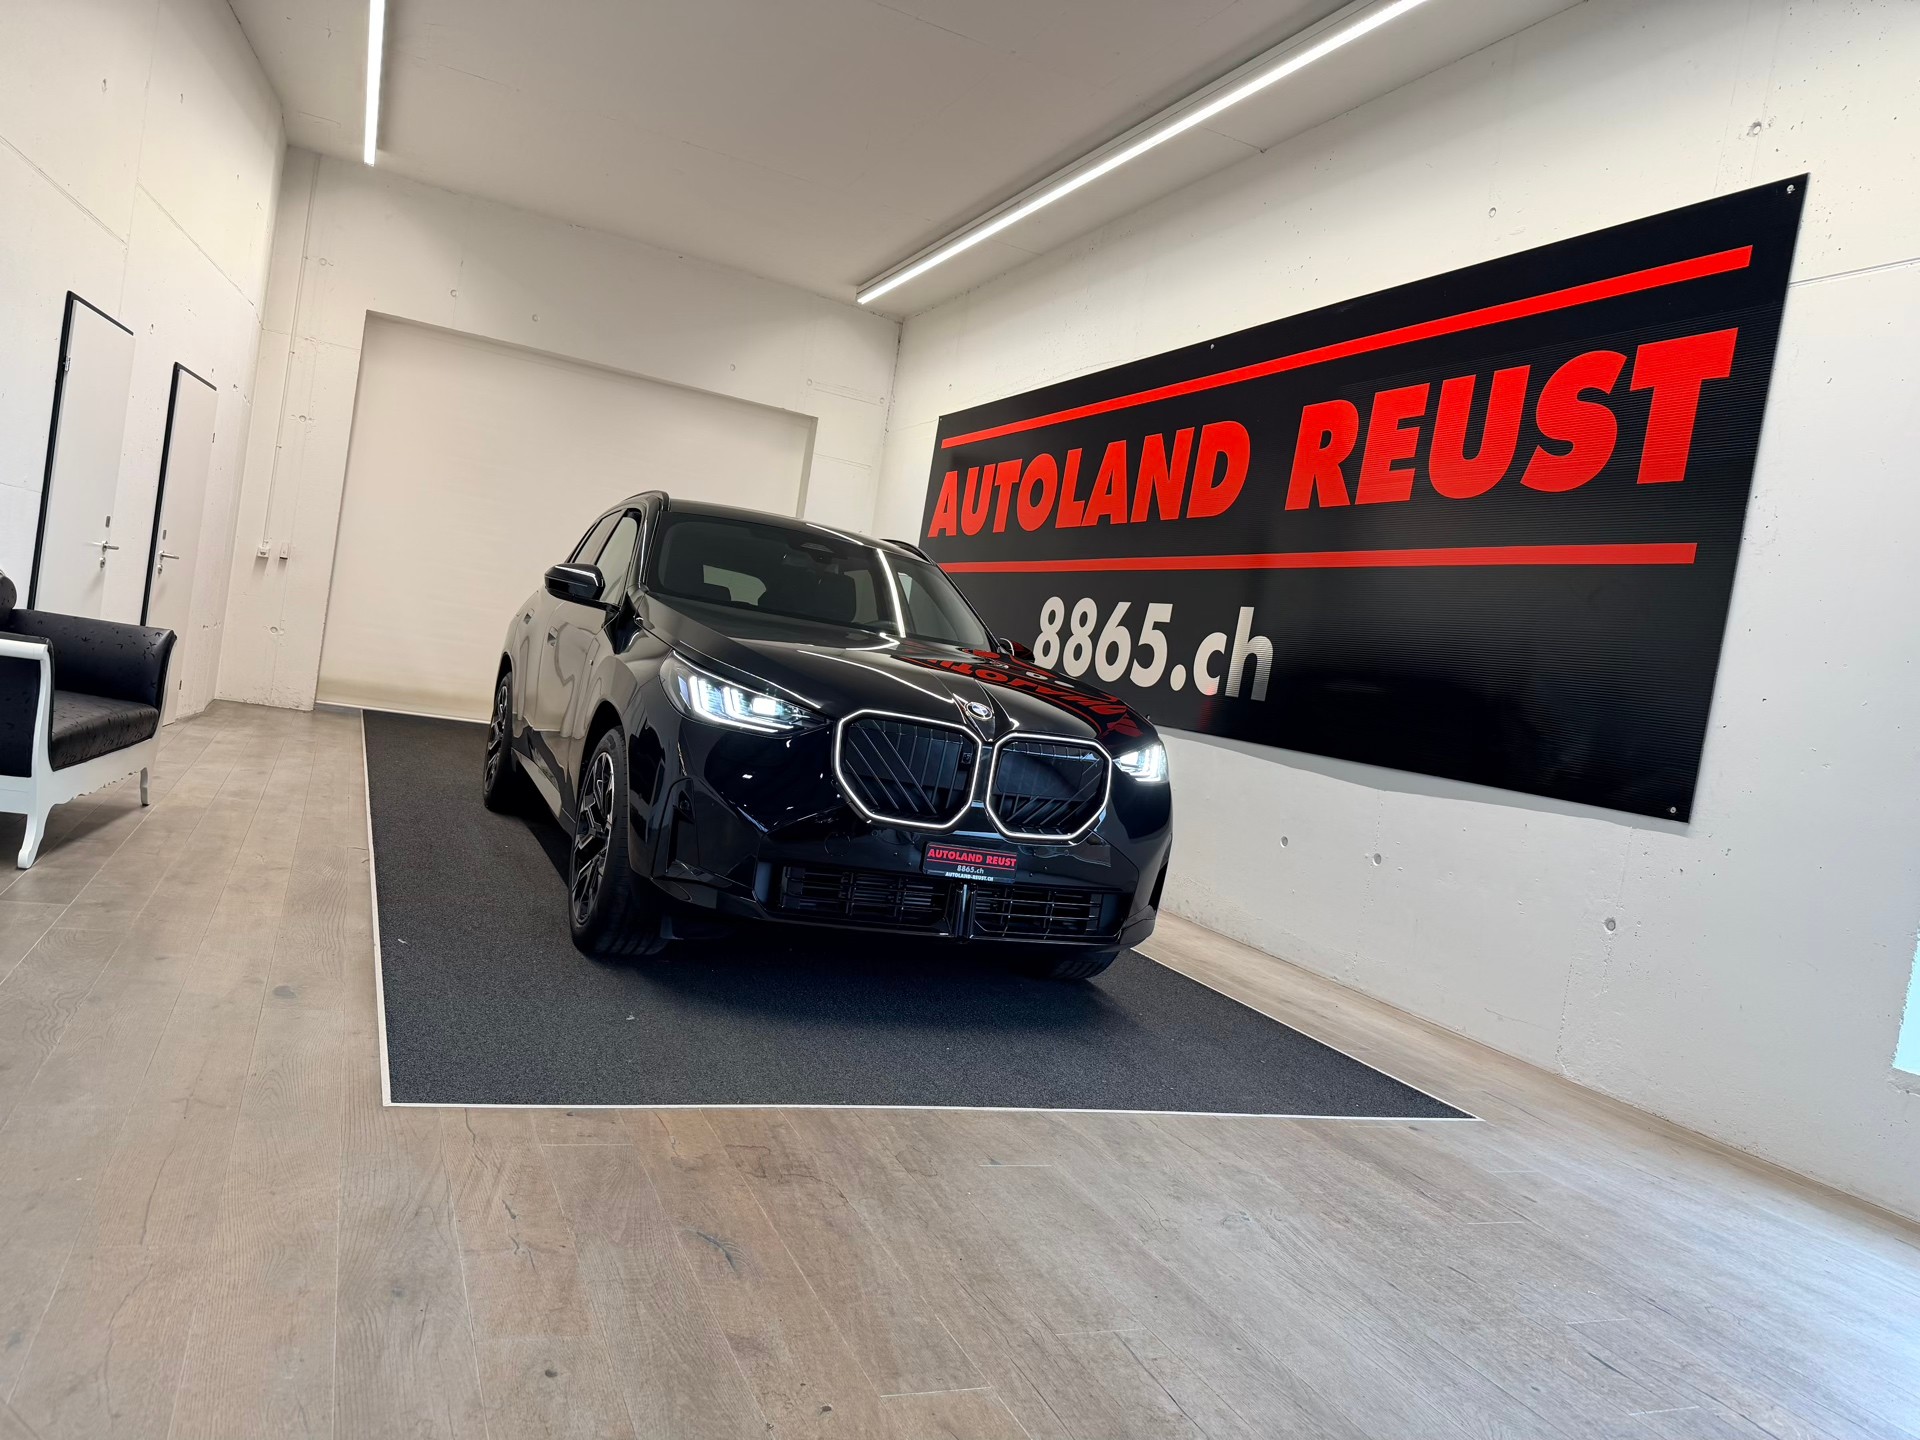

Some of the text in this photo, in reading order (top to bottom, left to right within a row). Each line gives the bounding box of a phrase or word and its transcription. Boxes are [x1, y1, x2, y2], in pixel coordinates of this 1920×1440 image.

[928, 327, 1740, 538] AUTOLAND REUST
[1033, 596, 1274, 701] 8865.ch
[928, 849, 1016, 867] AUTOLAND REUST
[956, 864, 984, 874] 8865.ch
